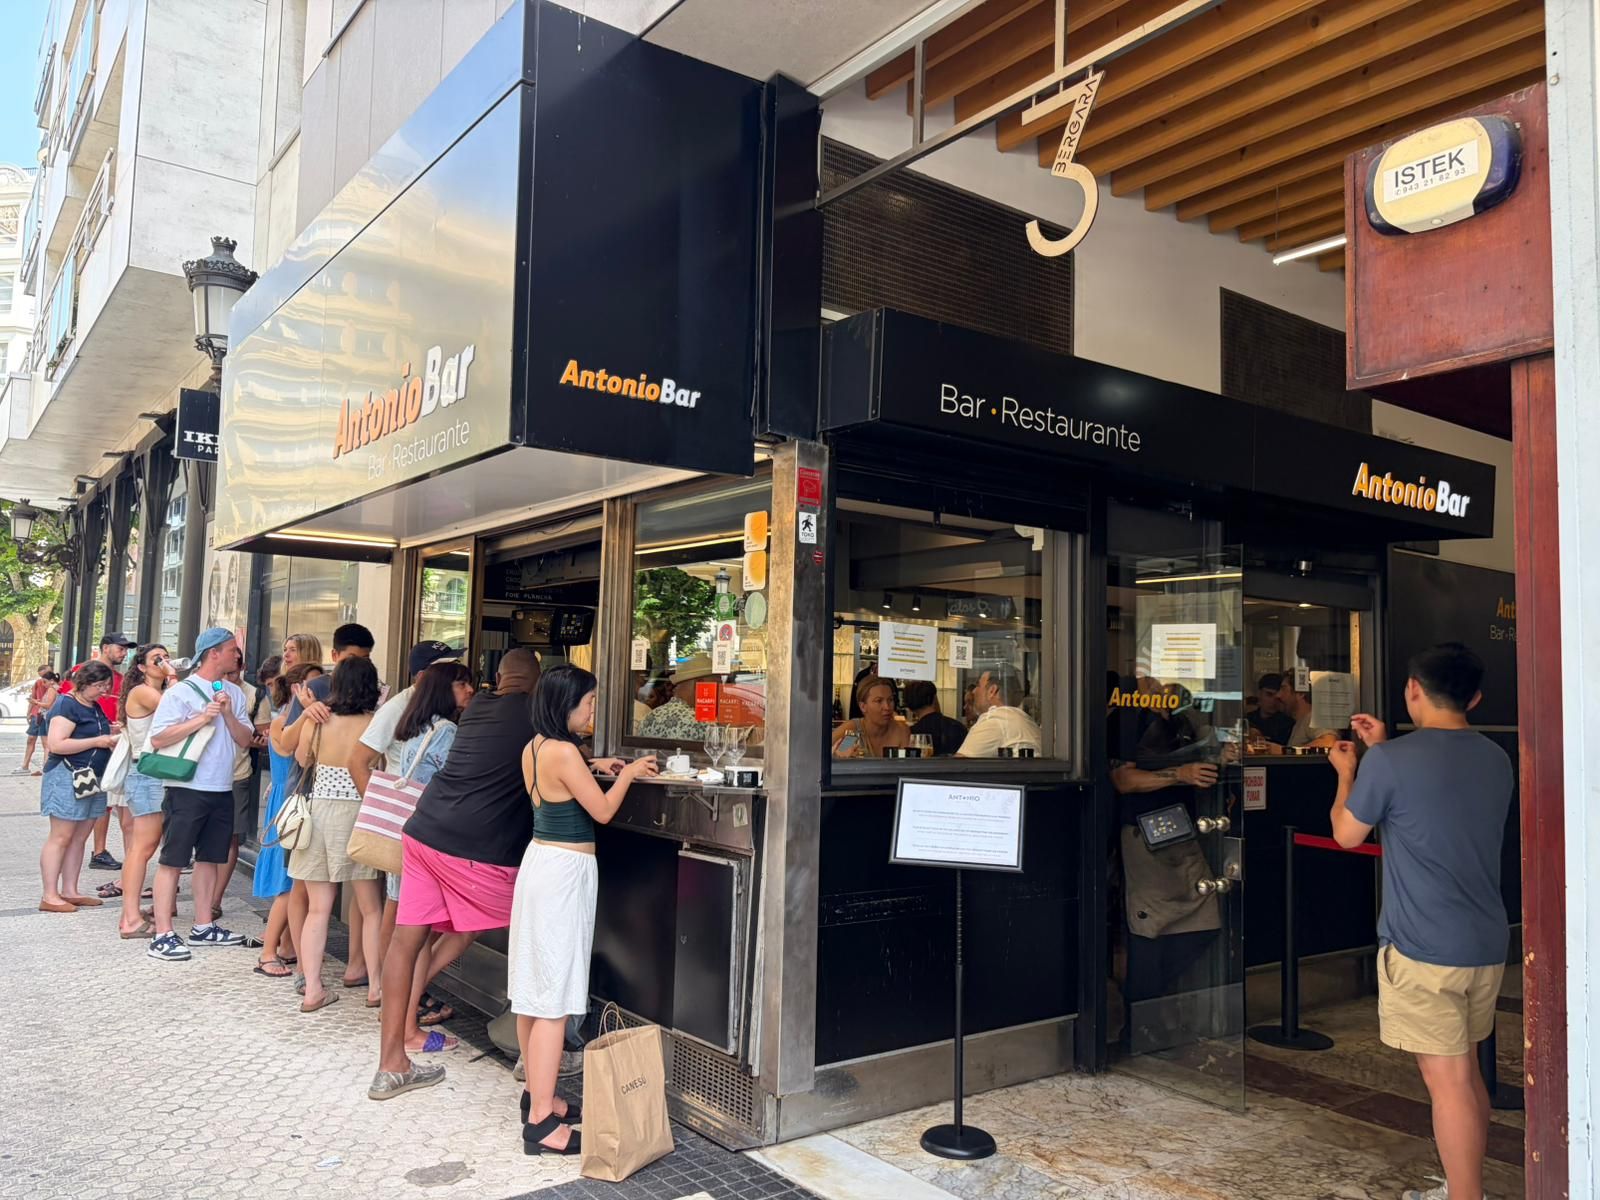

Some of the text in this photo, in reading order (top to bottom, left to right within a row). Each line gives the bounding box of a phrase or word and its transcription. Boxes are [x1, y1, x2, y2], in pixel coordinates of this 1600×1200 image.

[1053, 78, 1098, 173] BERGARA
[1394, 147, 1465, 188] ISTEK
[1402, 182, 1420, 195] 943
[1423, 178, 1434, 187] 21
[332, 344, 476, 460] AntonioBar
[559, 358, 701, 409] AntonioBar
[940, 383, 1141, 452] Bar Restaurante
[367, 418, 470, 481] Bar Restaurante
[1351, 462, 1471, 518] AntonioBar
